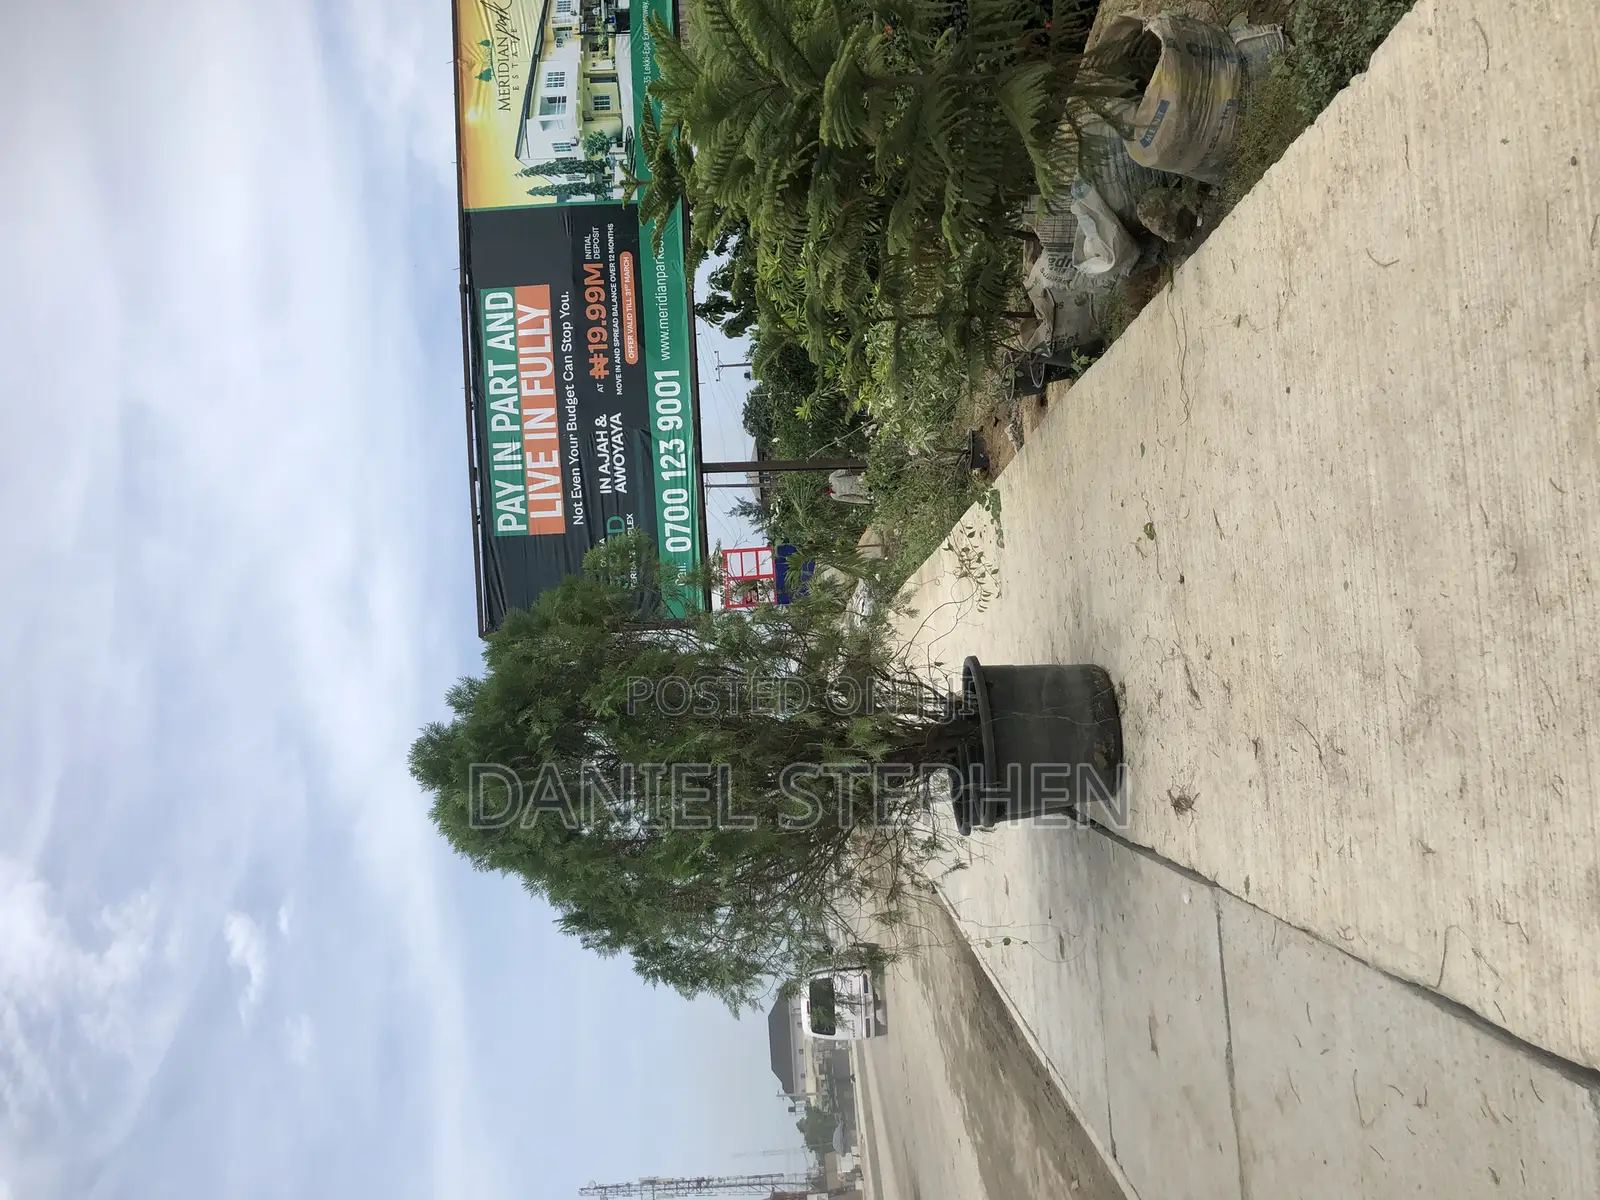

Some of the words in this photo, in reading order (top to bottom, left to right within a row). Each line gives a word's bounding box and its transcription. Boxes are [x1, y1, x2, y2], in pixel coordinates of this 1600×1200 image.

[496, 36, 511, 111] MERIDIAN
[511, 28, 519, 90] ESTATE
[642, 42, 651, 74] Lekki-Epe
[584, 234, 592, 260] INITIAL
[592, 226, 600, 259] DEPOSIT
[559, 292, 570, 319] You.
[611, 283, 619, 316] BALANCE
[484, 292, 514, 351] AND
[560, 322, 574, 352] Stop
[612, 318, 620, 346] SPREAD
[517, 304, 553, 396] FULLY
[562, 355, 573, 381] Can
[488, 360, 520, 432] PART
[597, 383, 604, 393] AT
[654, 370, 683, 431] 9001
[564, 384, 579, 430] Budget
[594, 414, 607, 428] &
[522, 408, 557, 440] IN
[492, 440, 522, 471] IN
[566, 434, 579, 465] Your
[595, 431, 611, 474] AJAH
[609, 412, 627, 494] AWOYAYA
[659, 438, 686, 481] 123
[526, 450, 562, 518] LIVE
[570, 468, 581, 498] Even
[599, 478, 612, 494] IN
[495, 480, 526, 532] PAY
[572, 501, 584, 525] Not
[662, 488, 692, 552] 0700
